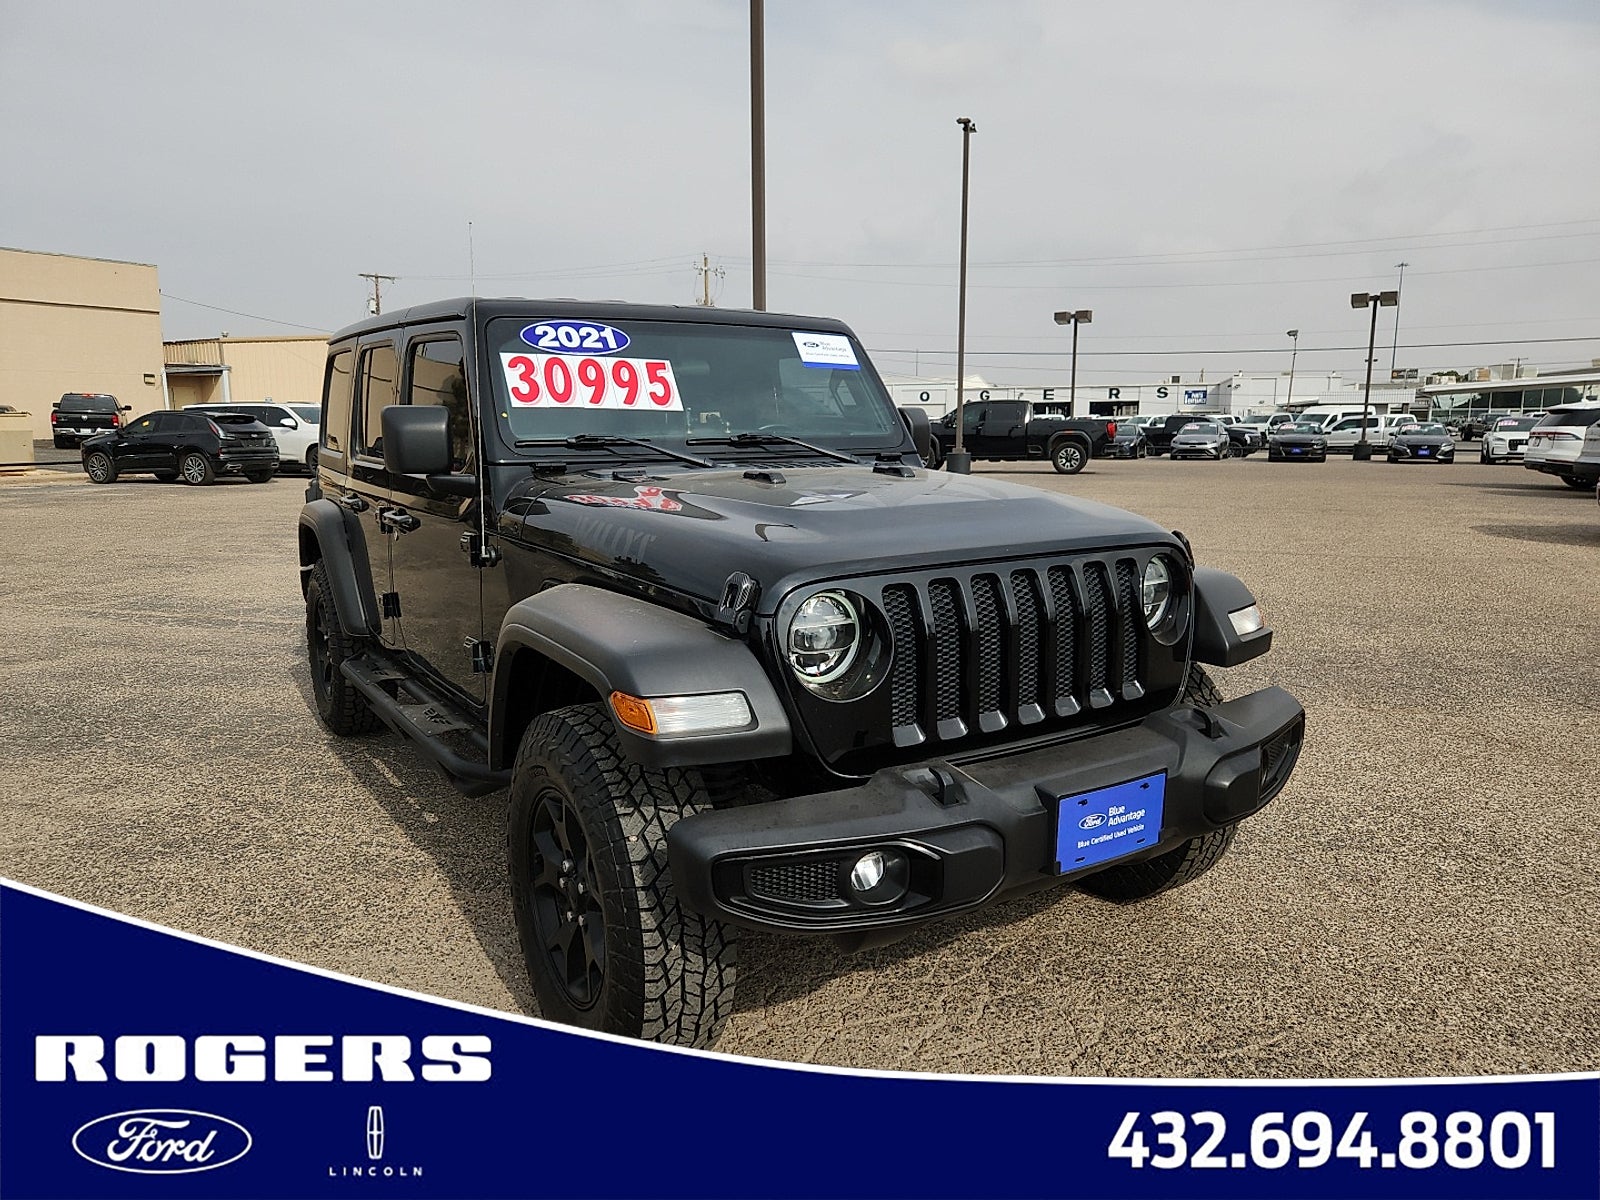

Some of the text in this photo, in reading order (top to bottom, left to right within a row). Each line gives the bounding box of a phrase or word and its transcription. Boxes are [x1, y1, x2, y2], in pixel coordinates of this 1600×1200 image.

[534, 325, 618, 349] 2021
[508, 355, 674, 406] 30995
[919, 387, 1170, 402] OGERS
[1108, 805, 1126, 817] Blue
[1108, 808, 1147, 827] Advantage
[1077, 823, 1145, 849] Blue Certified Used Vehicle
